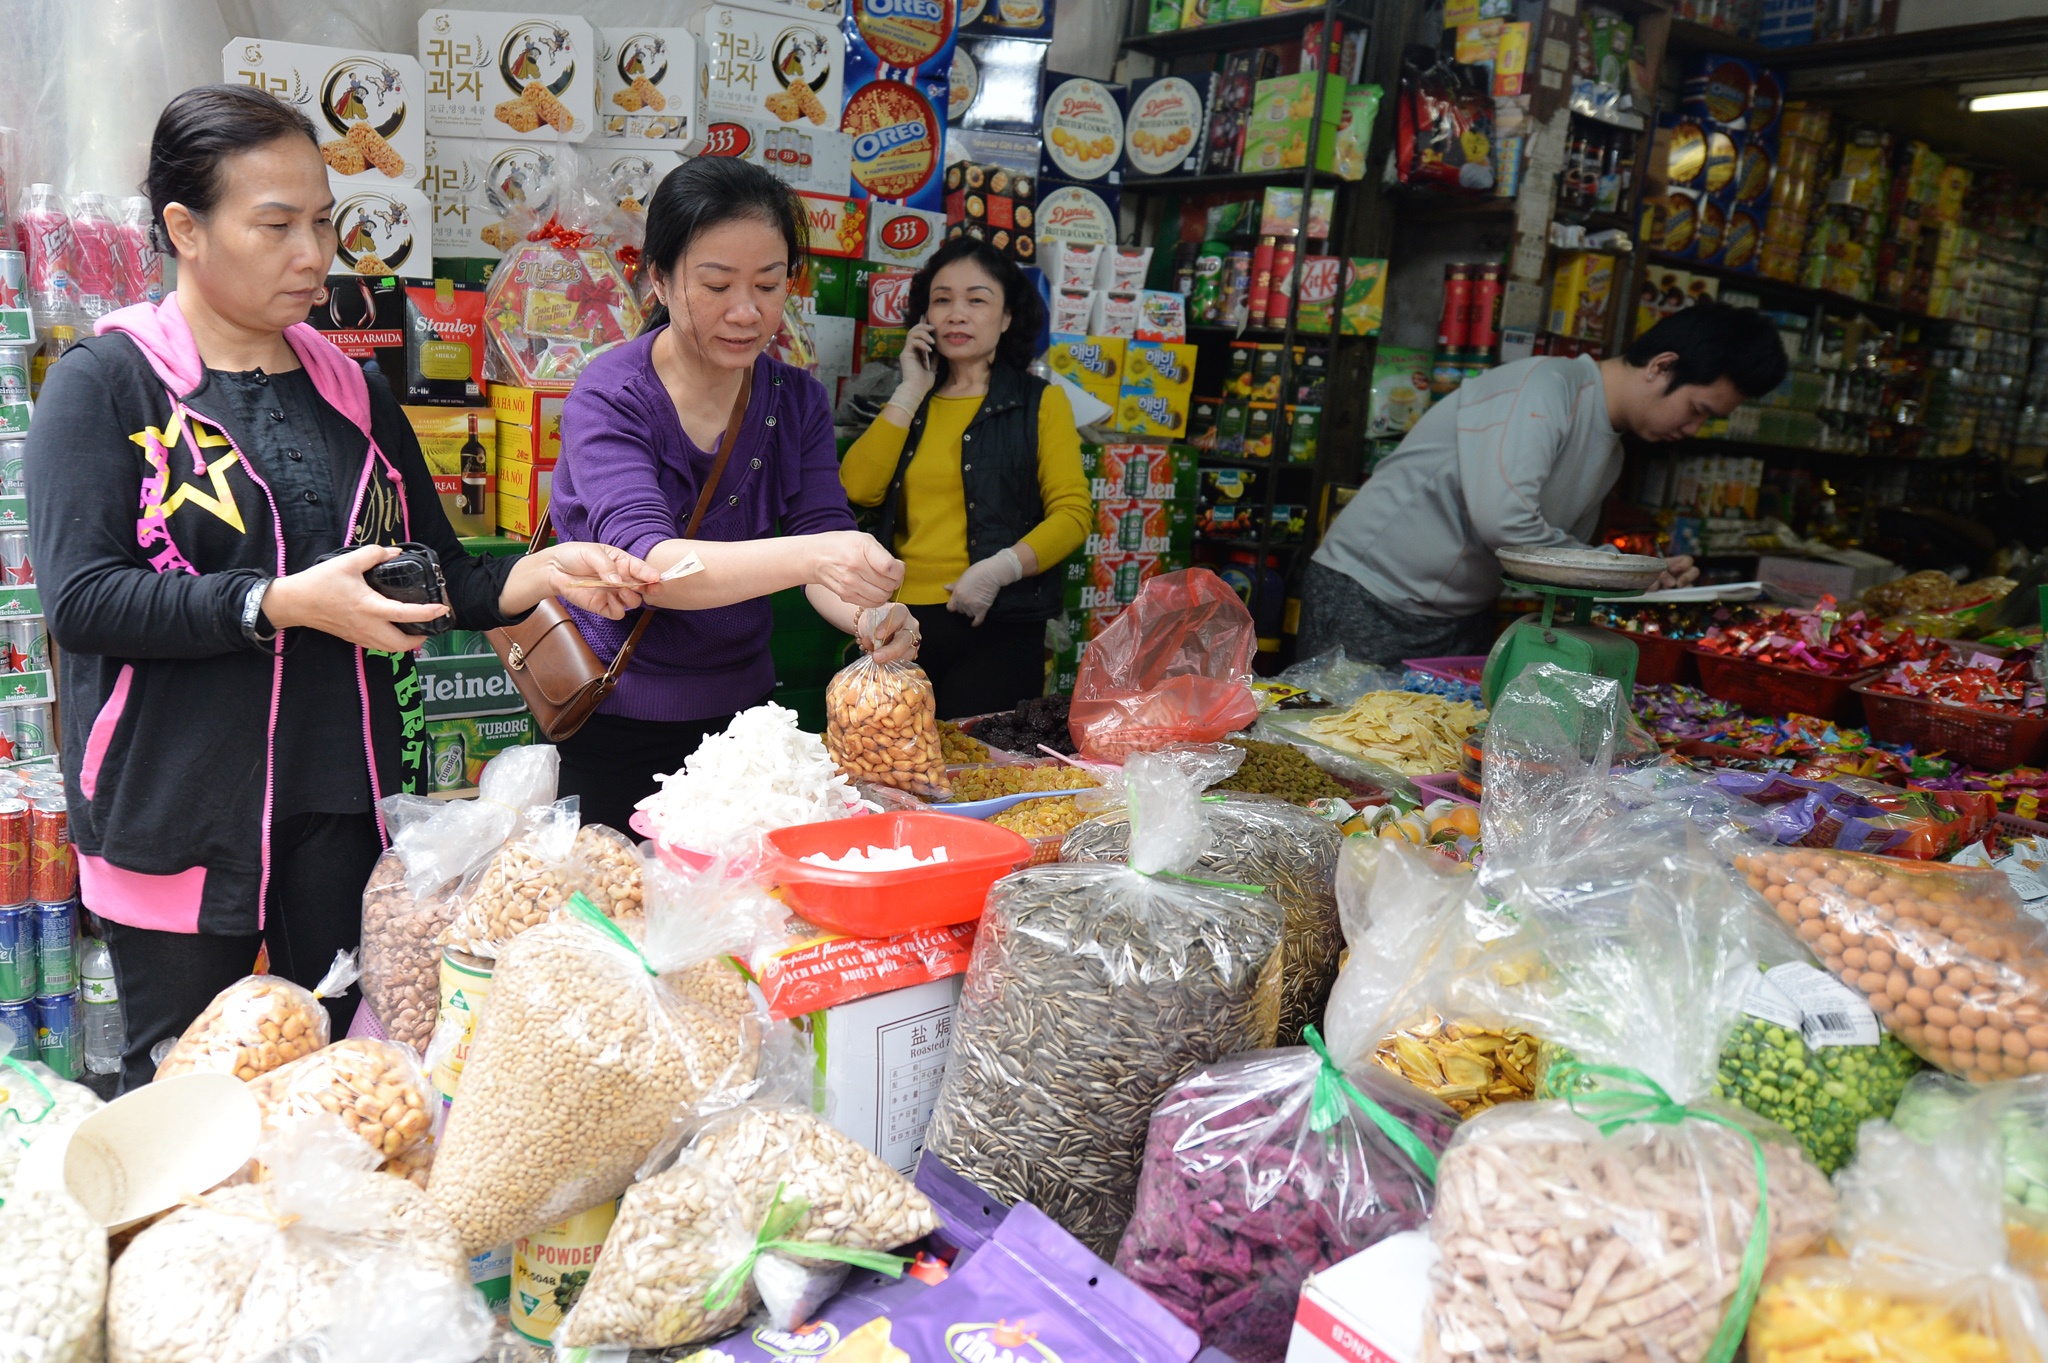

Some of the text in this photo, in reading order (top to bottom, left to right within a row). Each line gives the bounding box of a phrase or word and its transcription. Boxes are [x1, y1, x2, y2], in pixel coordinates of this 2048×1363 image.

[427, 70, 484, 102] 과자
[1059, 97, 1104, 117] Danisa
[1142, 94, 1184, 117] Danisa
[707, 128, 735, 153] 333
[855, 122, 925, 158] OREO
[809, 210, 837, 235] NỘI
[1049, 206, 1096, 225] Danisa
[893, 221, 918, 243] 333
[856, 269, 869, 282] 24
[415, 317, 477, 337] Stanley
[323, 333, 402, 344] NTESSA ARMIDA
[430, 345, 462, 353] CABERNET
[409, 386, 417, 394] 2L
[490, 395, 525, 413] BIA HÀ NỘI
[435, 481, 458, 491] REAL
[500, 469, 523, 487] HÀ NỘI
[1091, 477, 1176, 500] Heiken
[1084, 533, 1171, 555] Heiken
[1068, 563, 1080, 576] 24
[418, 669, 521, 702] Heinek
[5, 692, 38, 700] Heineken
[476, 717, 529, 737] TUBORG
[438, 746, 461, 783] TUBORG
[766, 941, 857, 978] Tropical flavor
[810, 960, 836, 976] RAU
[837, 954, 862, 968] CÂU
[839, 965, 875, 982] NHIỆT
[910, 1038, 945, 1059] Roasted
[537, 1244, 603, 1266] POWDER
